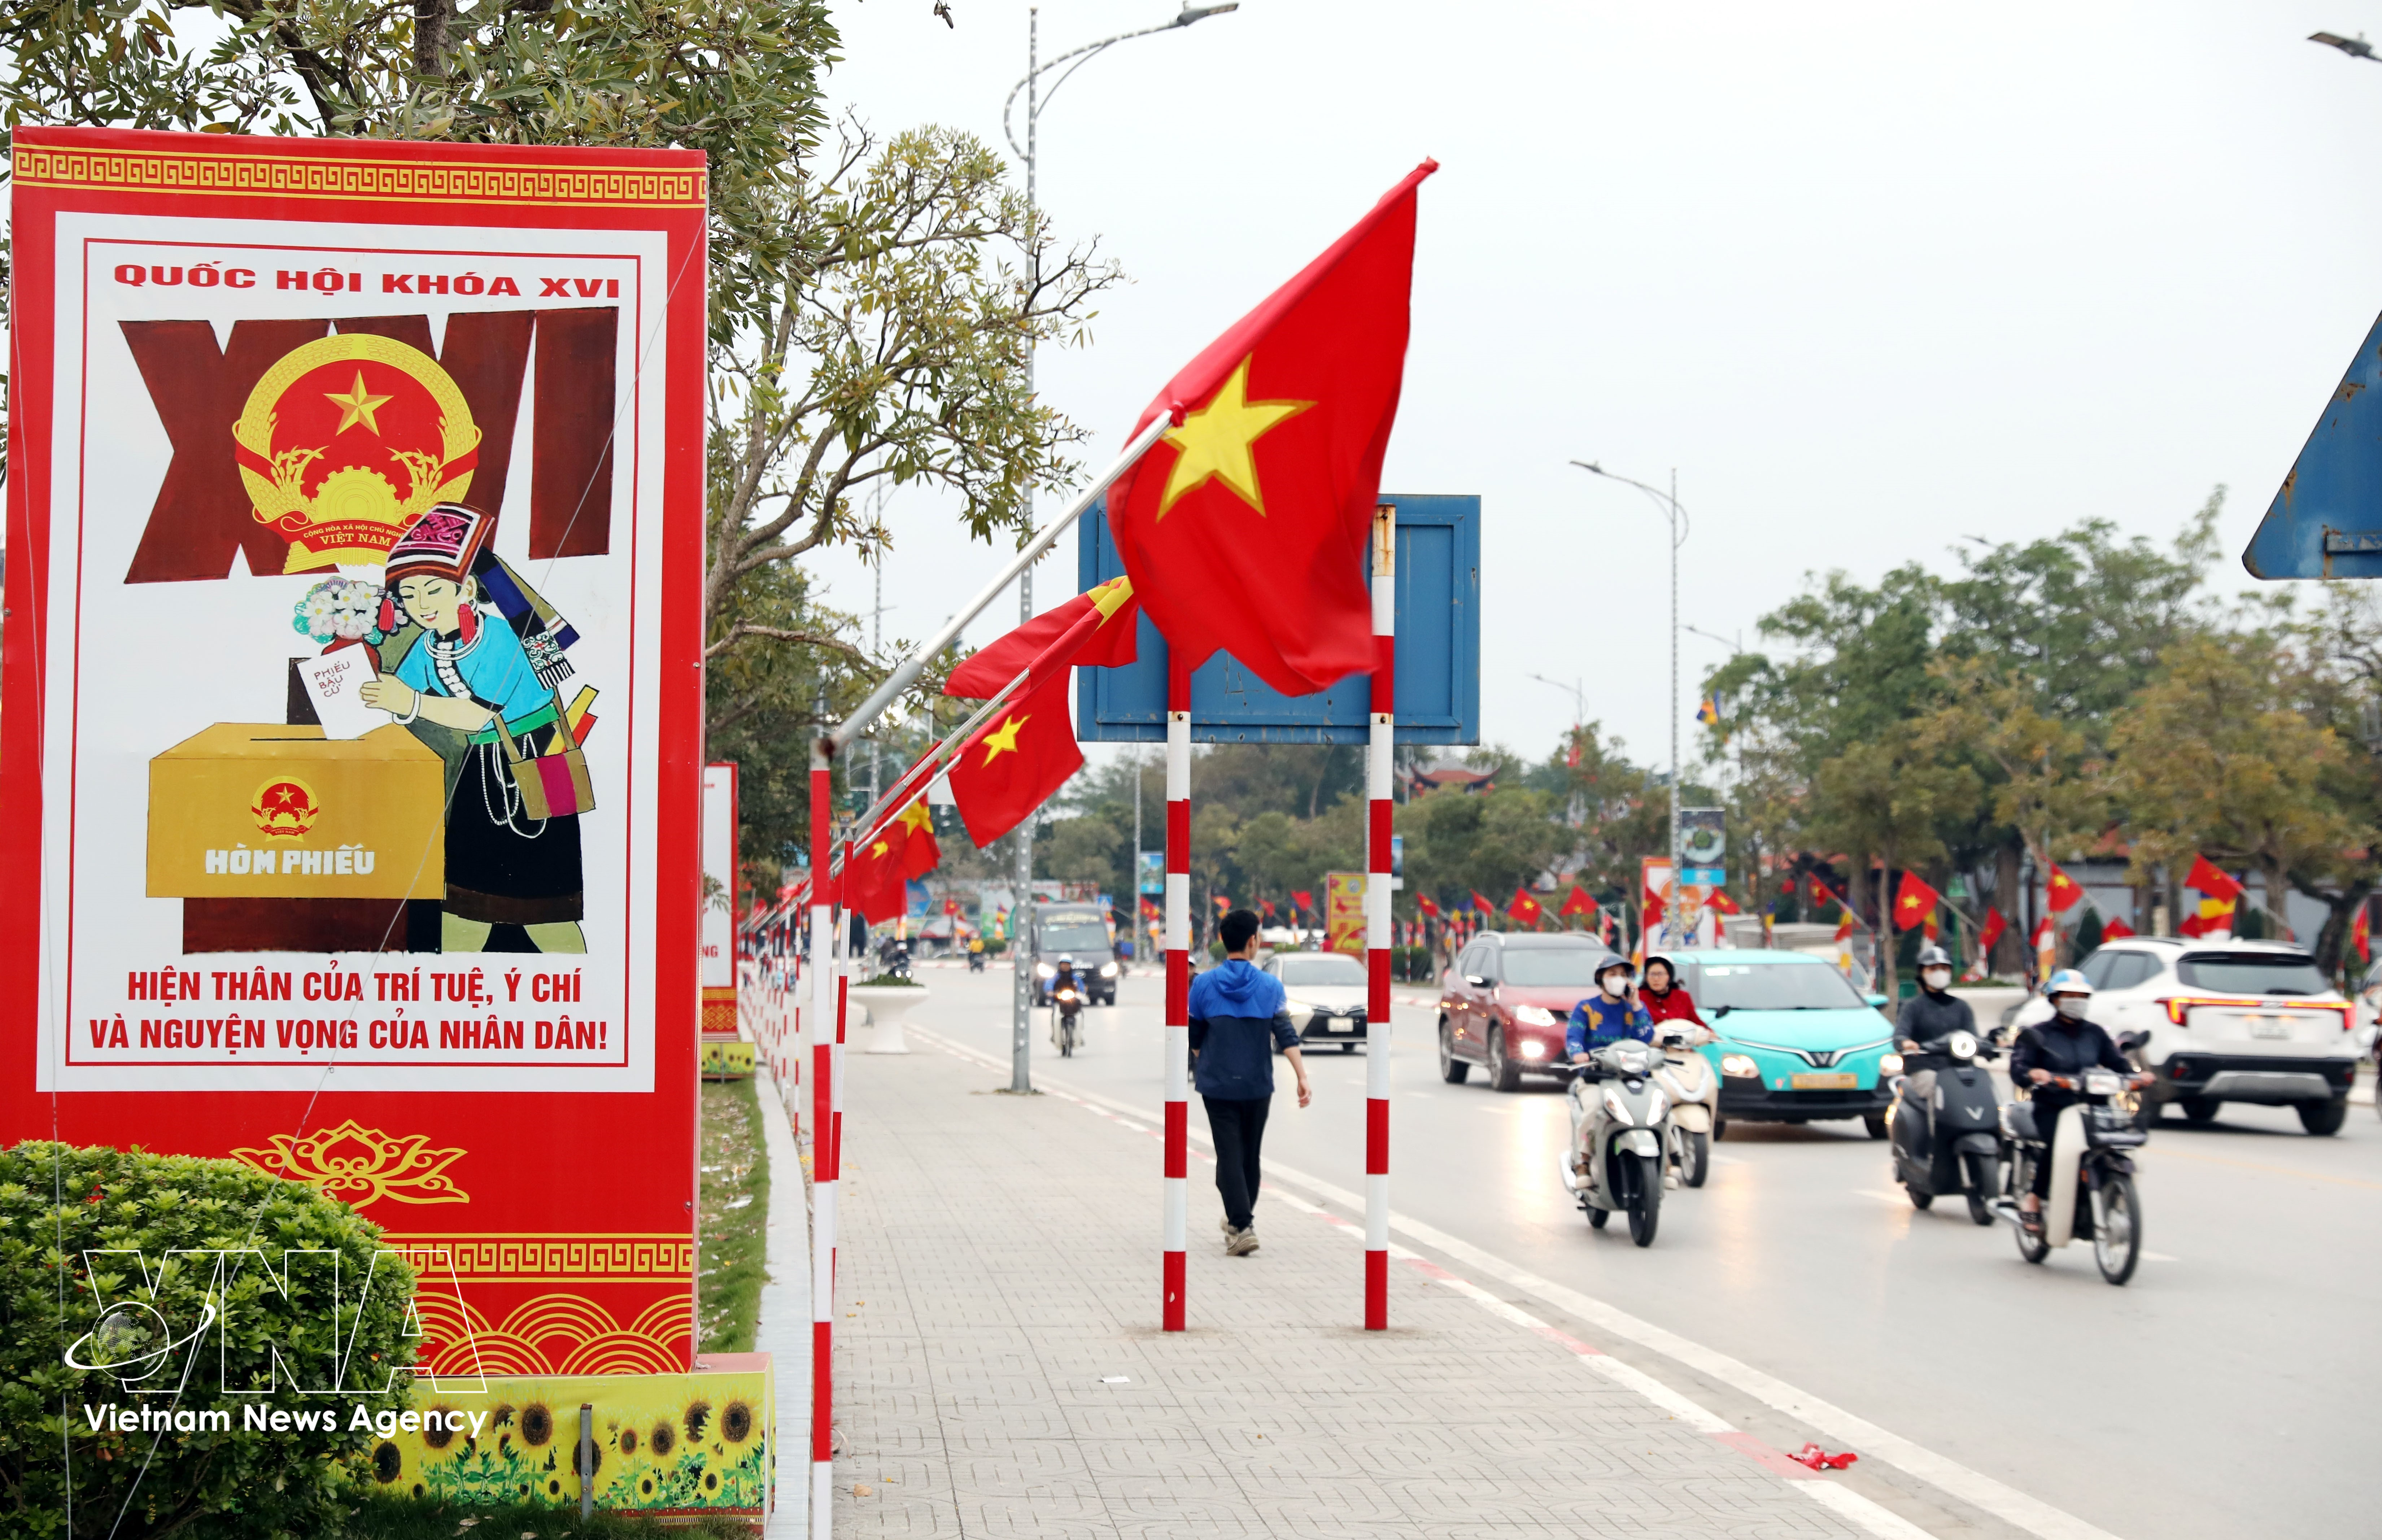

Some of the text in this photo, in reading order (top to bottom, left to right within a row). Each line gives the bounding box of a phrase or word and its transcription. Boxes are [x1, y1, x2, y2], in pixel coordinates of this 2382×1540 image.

[115, 261, 619, 298] QUỐC HỘI KHÓA XVI
[304, 528, 324, 538] CỘNG
[319, 531, 392, 546] VIỆT NAM
[205, 842, 375, 874] HÒM PHIẾU
[128, 960, 581, 1008] HIỆN THÂN CỦA TRÍ TUỆ, Ý CHÍ
[90, 1008, 607, 1055] VÀ NGUYỆN VỌNG CỦA NHÂN DÂN!
